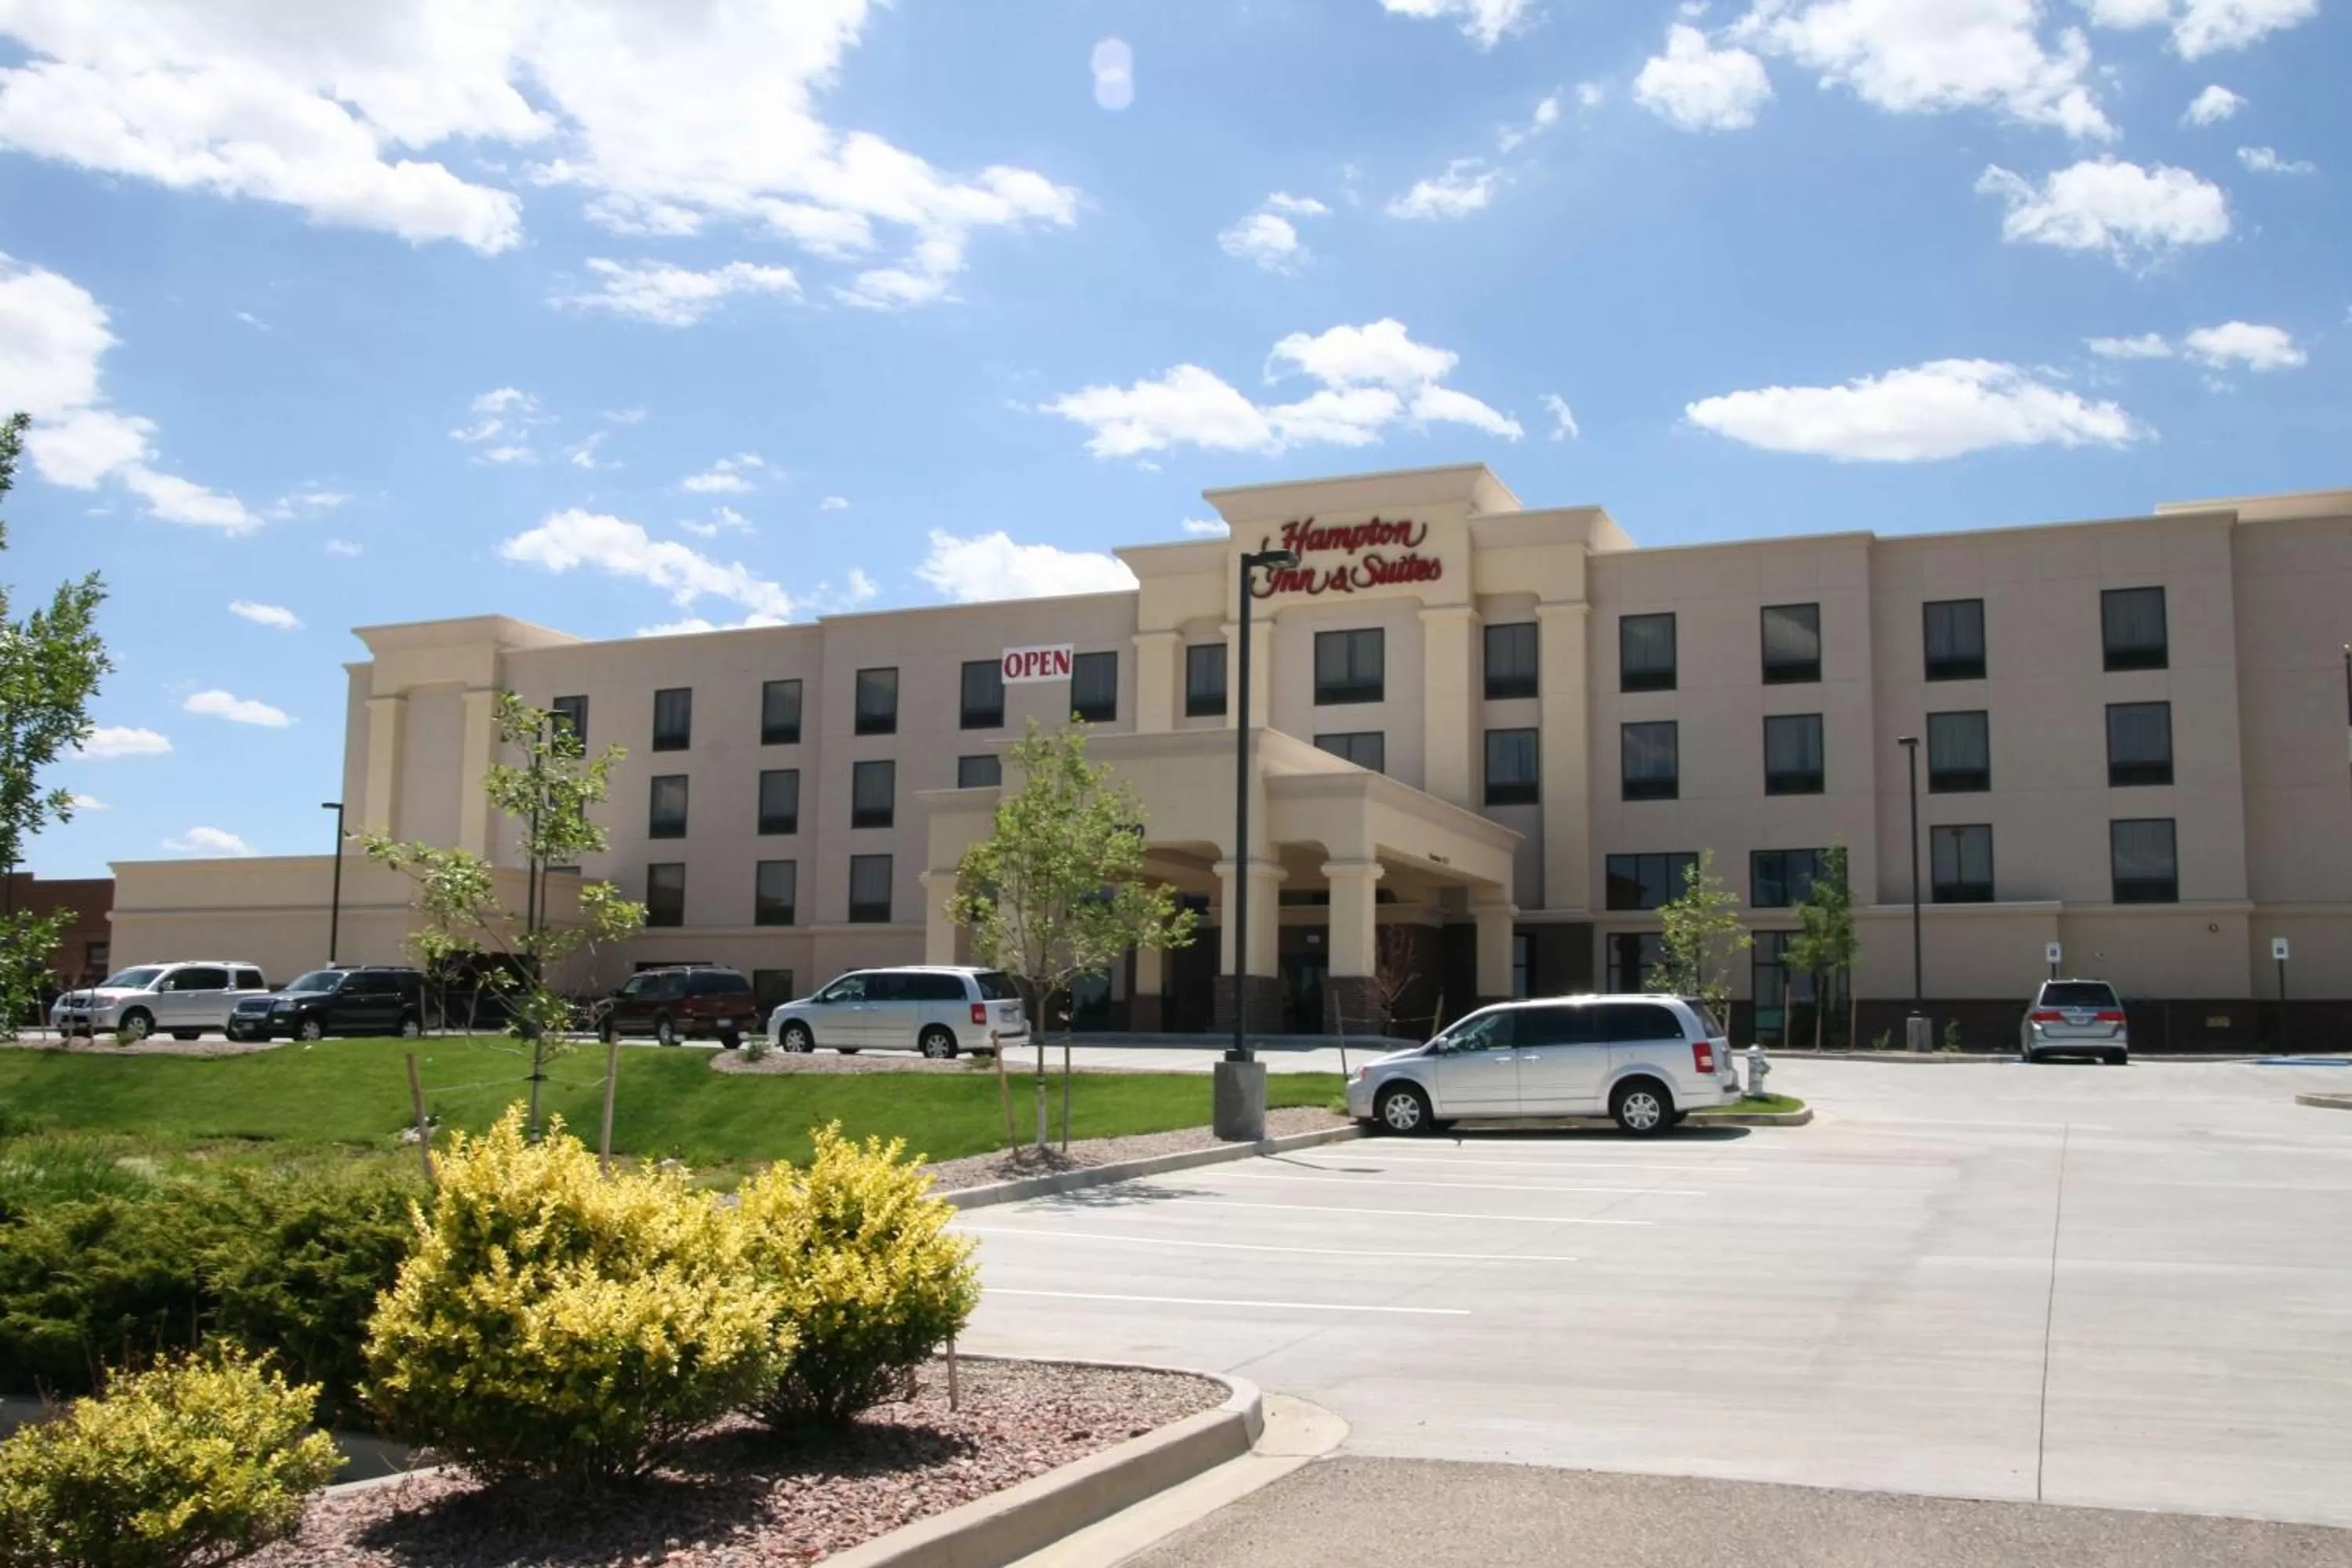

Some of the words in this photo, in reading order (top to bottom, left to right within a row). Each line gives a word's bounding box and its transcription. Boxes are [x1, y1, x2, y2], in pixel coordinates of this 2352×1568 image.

[1261, 517, 1428, 555] Hampton
[1250, 563, 1330, 599] Inn
[1350, 552, 1442, 588] Suites
[1004, 649, 1070, 678] OPEN
